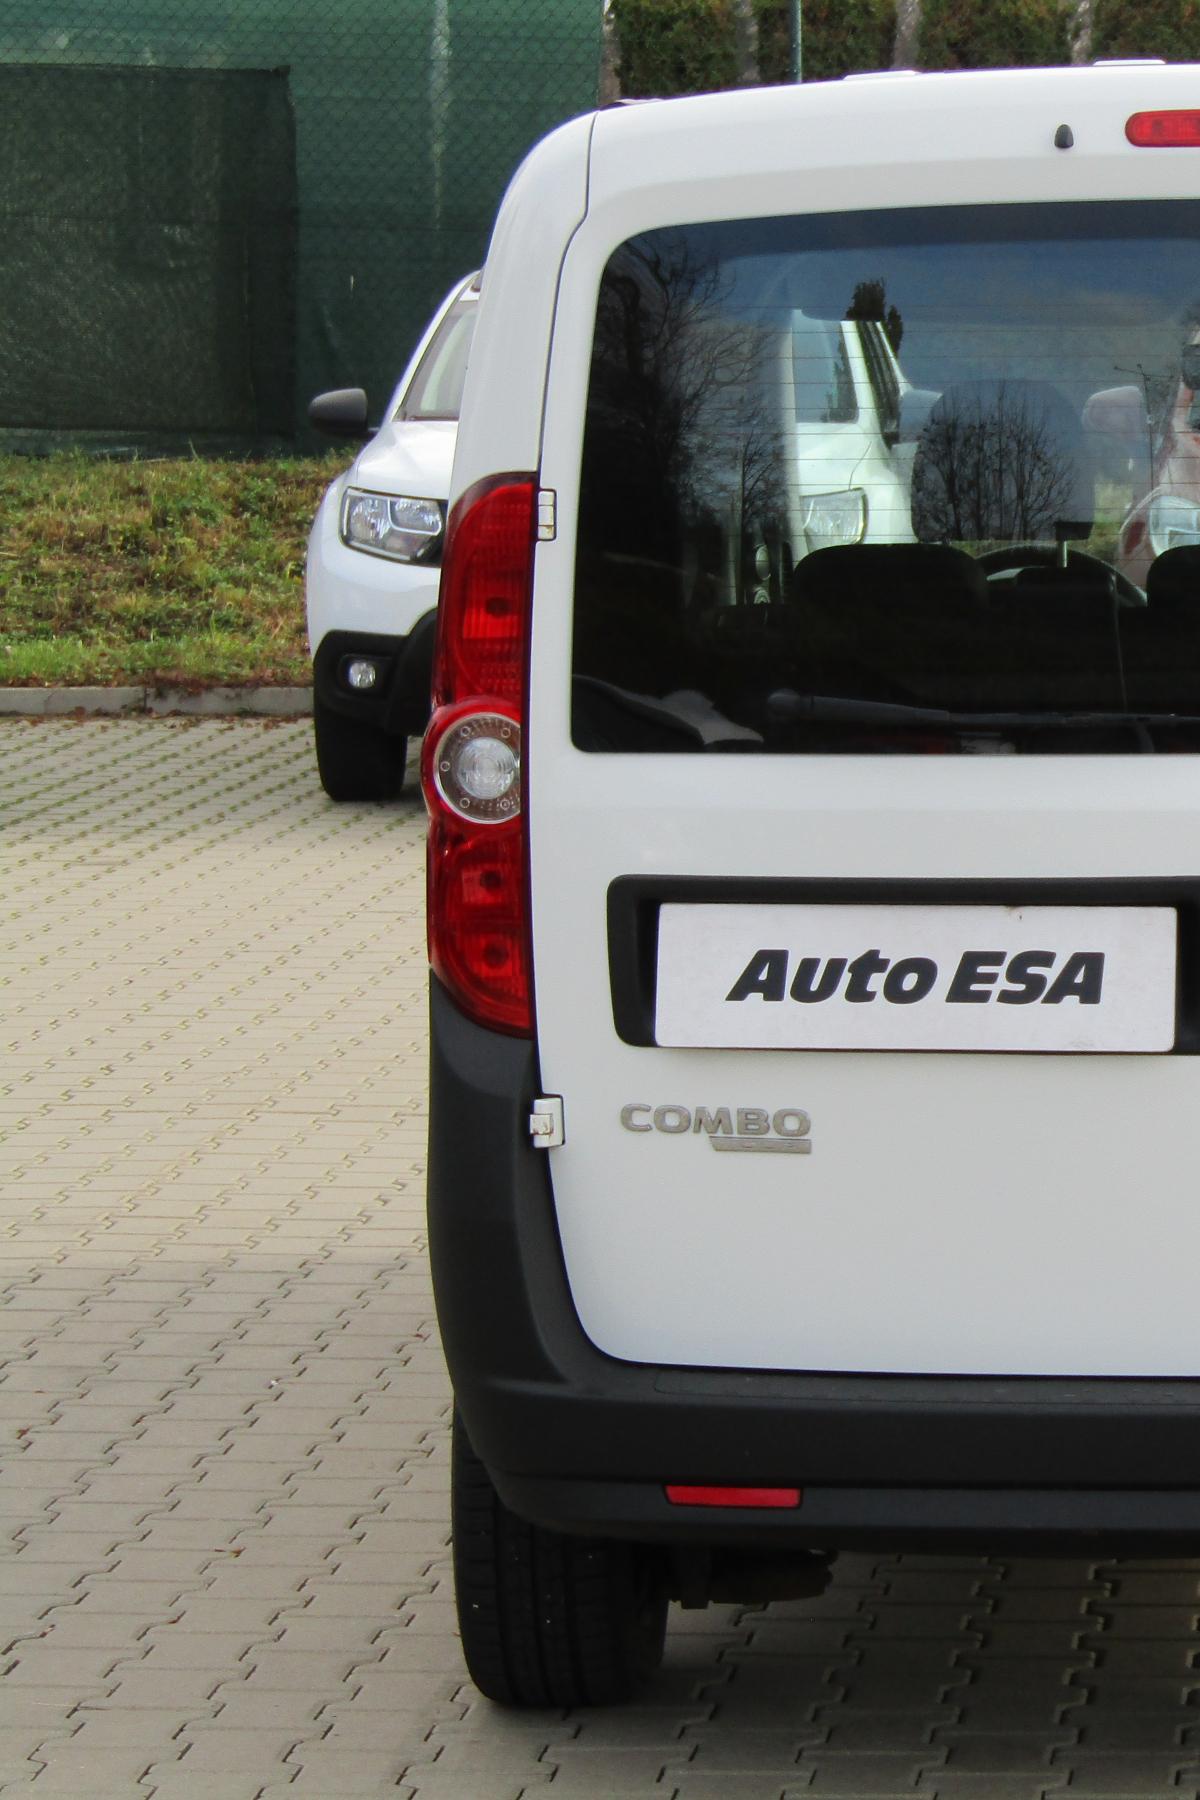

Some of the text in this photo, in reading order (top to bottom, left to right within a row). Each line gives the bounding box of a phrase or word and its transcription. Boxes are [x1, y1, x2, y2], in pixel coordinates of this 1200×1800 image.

[725, 949, 1105, 1005] Auto ESA
[620, 1103, 811, 1137] COMBO
